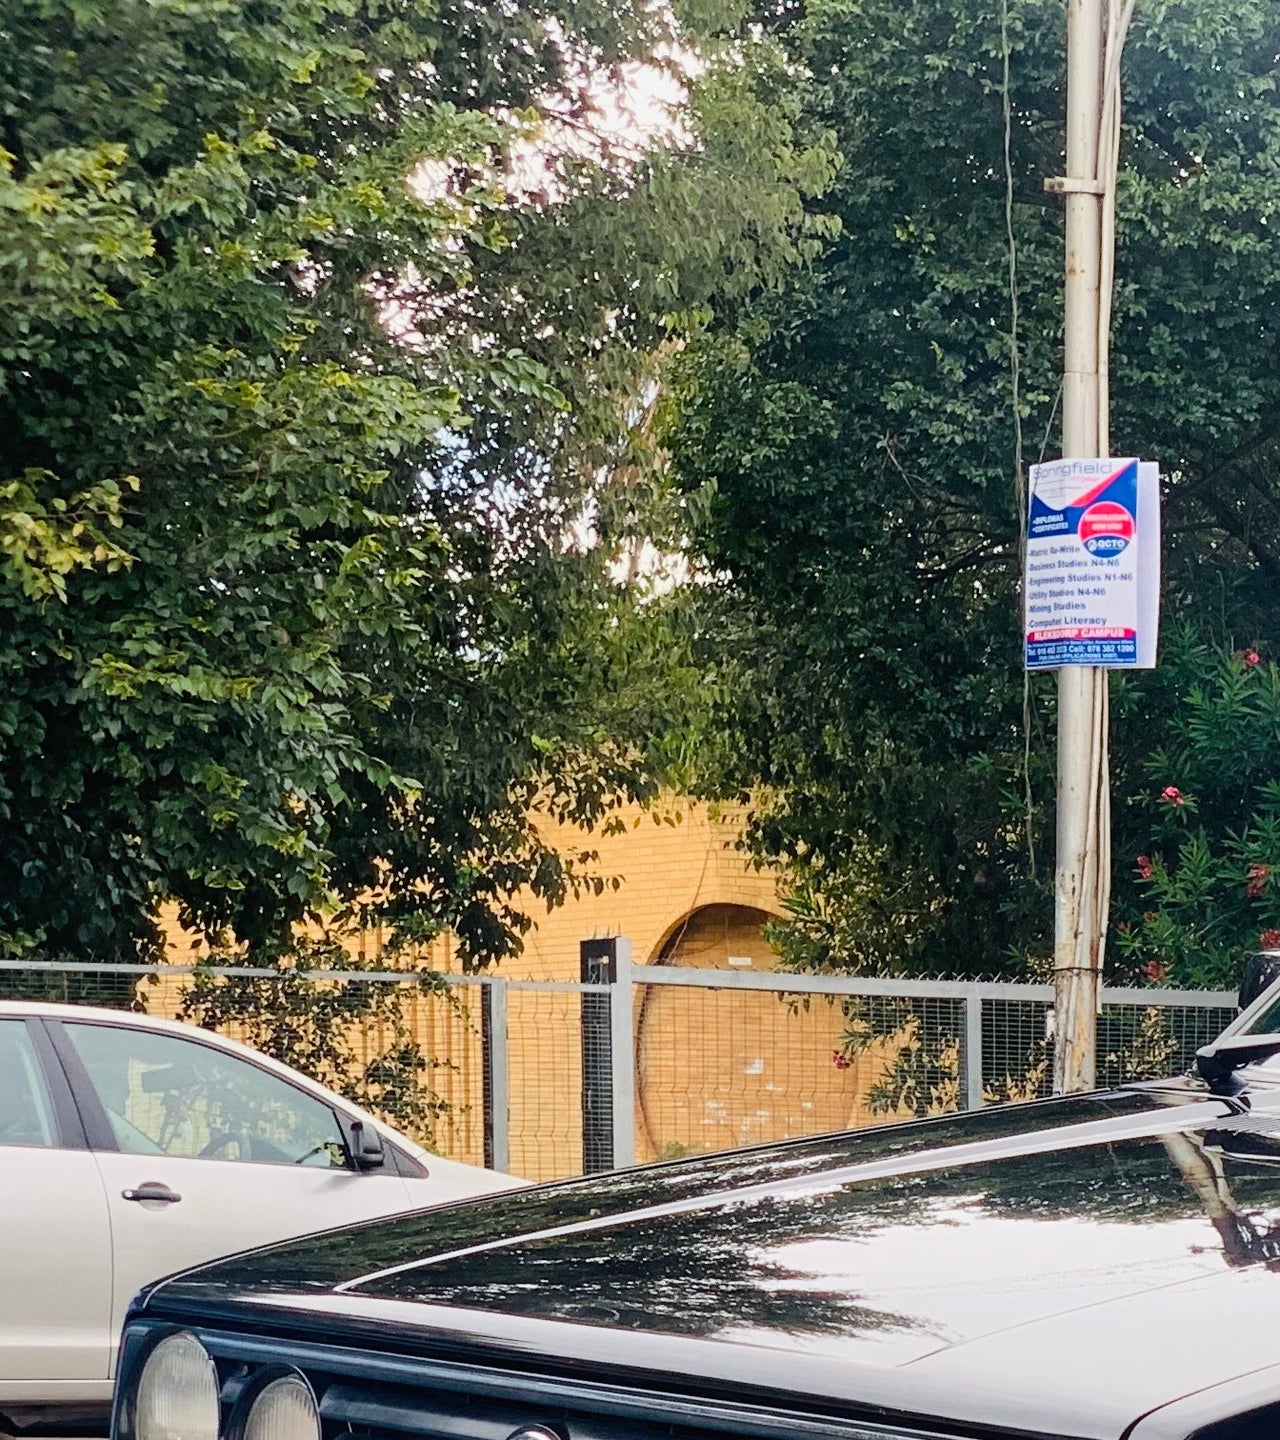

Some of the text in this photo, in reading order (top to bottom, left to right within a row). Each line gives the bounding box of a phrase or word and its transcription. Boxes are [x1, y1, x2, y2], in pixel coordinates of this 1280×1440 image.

[1058, 560, 1088, 568] Studies
[1068, 574, 1101, 582] Studies
[1049, 589, 1074, 598] Studies
[1077, 588, 1106, 596] N4-N6
[1053, 602, 1086, 610] Studies
[1064, 616, 1107, 626] Literacy
